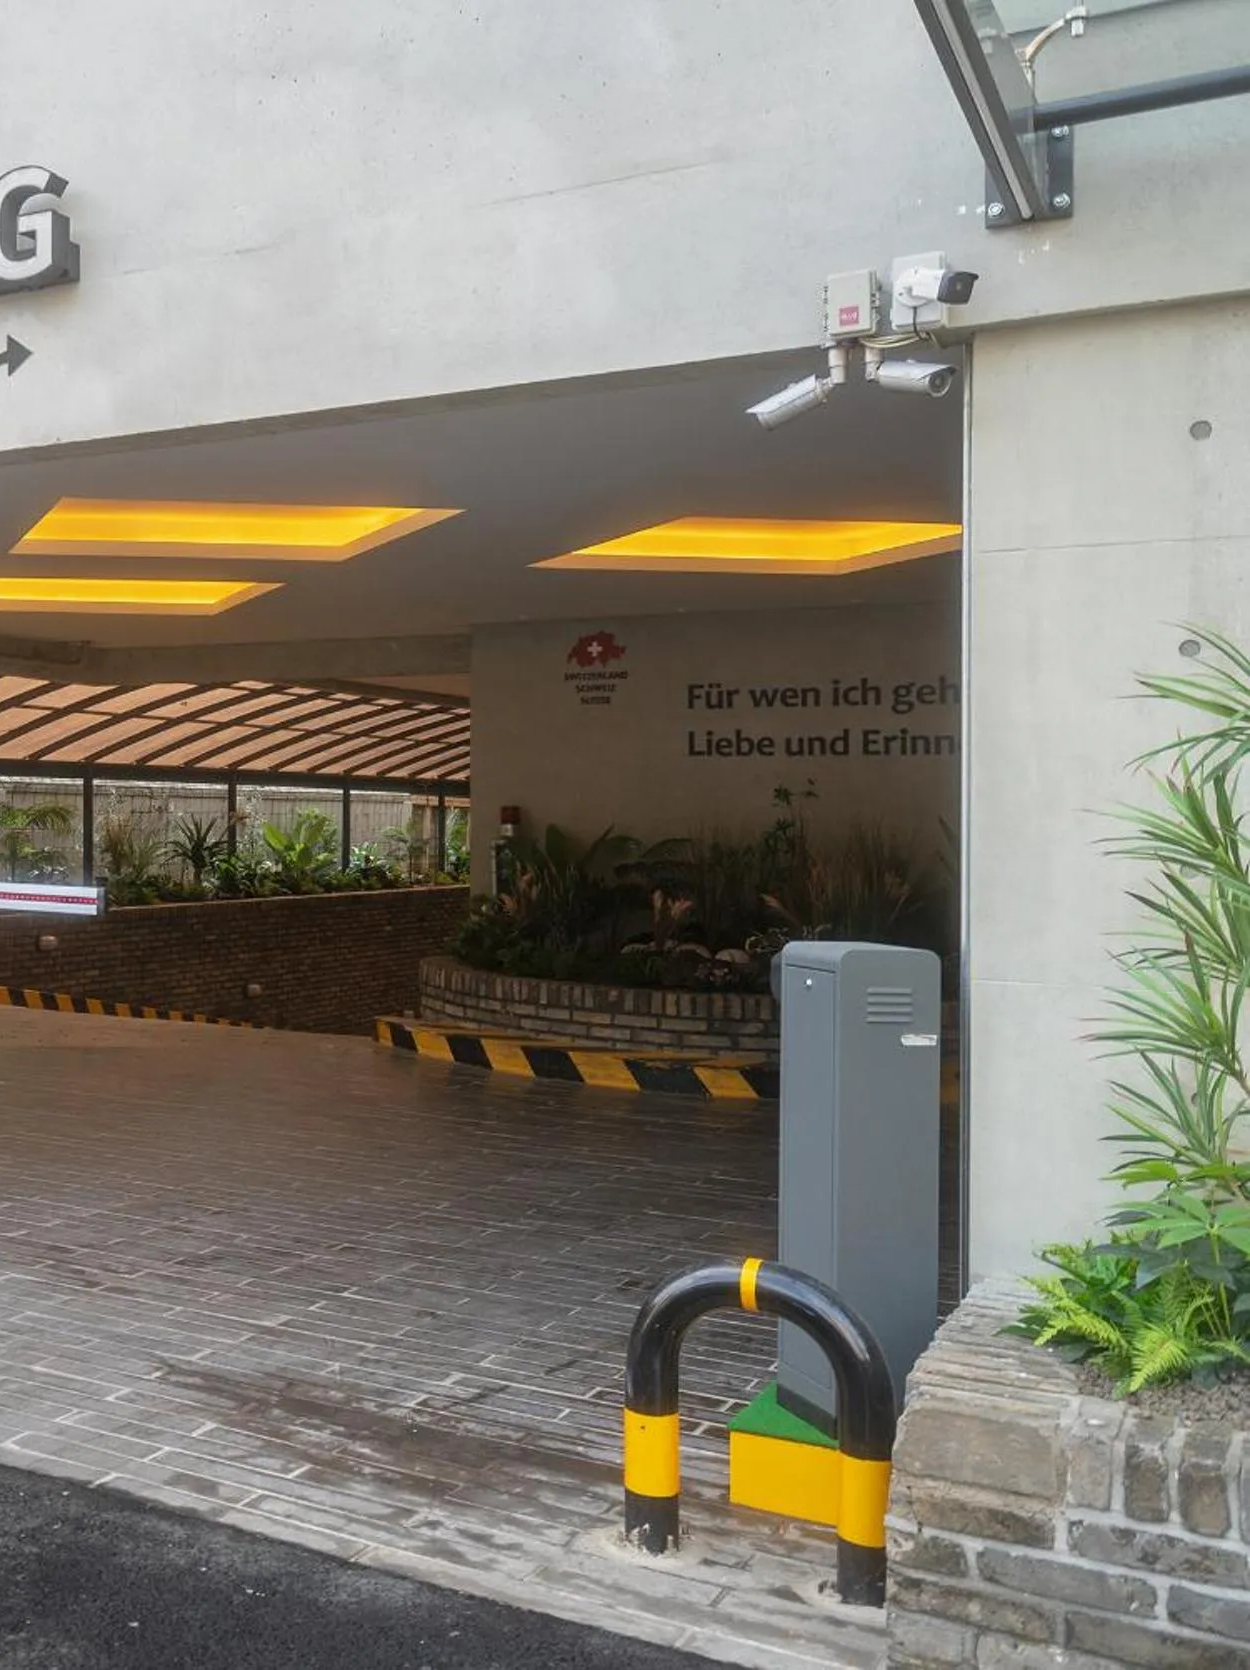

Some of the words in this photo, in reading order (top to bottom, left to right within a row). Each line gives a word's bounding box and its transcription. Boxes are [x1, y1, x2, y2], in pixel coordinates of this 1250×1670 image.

[687, 682, 740, 709] Für
[749, 685, 822, 708] wen
[831, 678, 882, 708] ich
[687, 729, 775, 757] Liebe
[784, 728, 851, 757] und
[861, 728, 961, 756] Erinn
